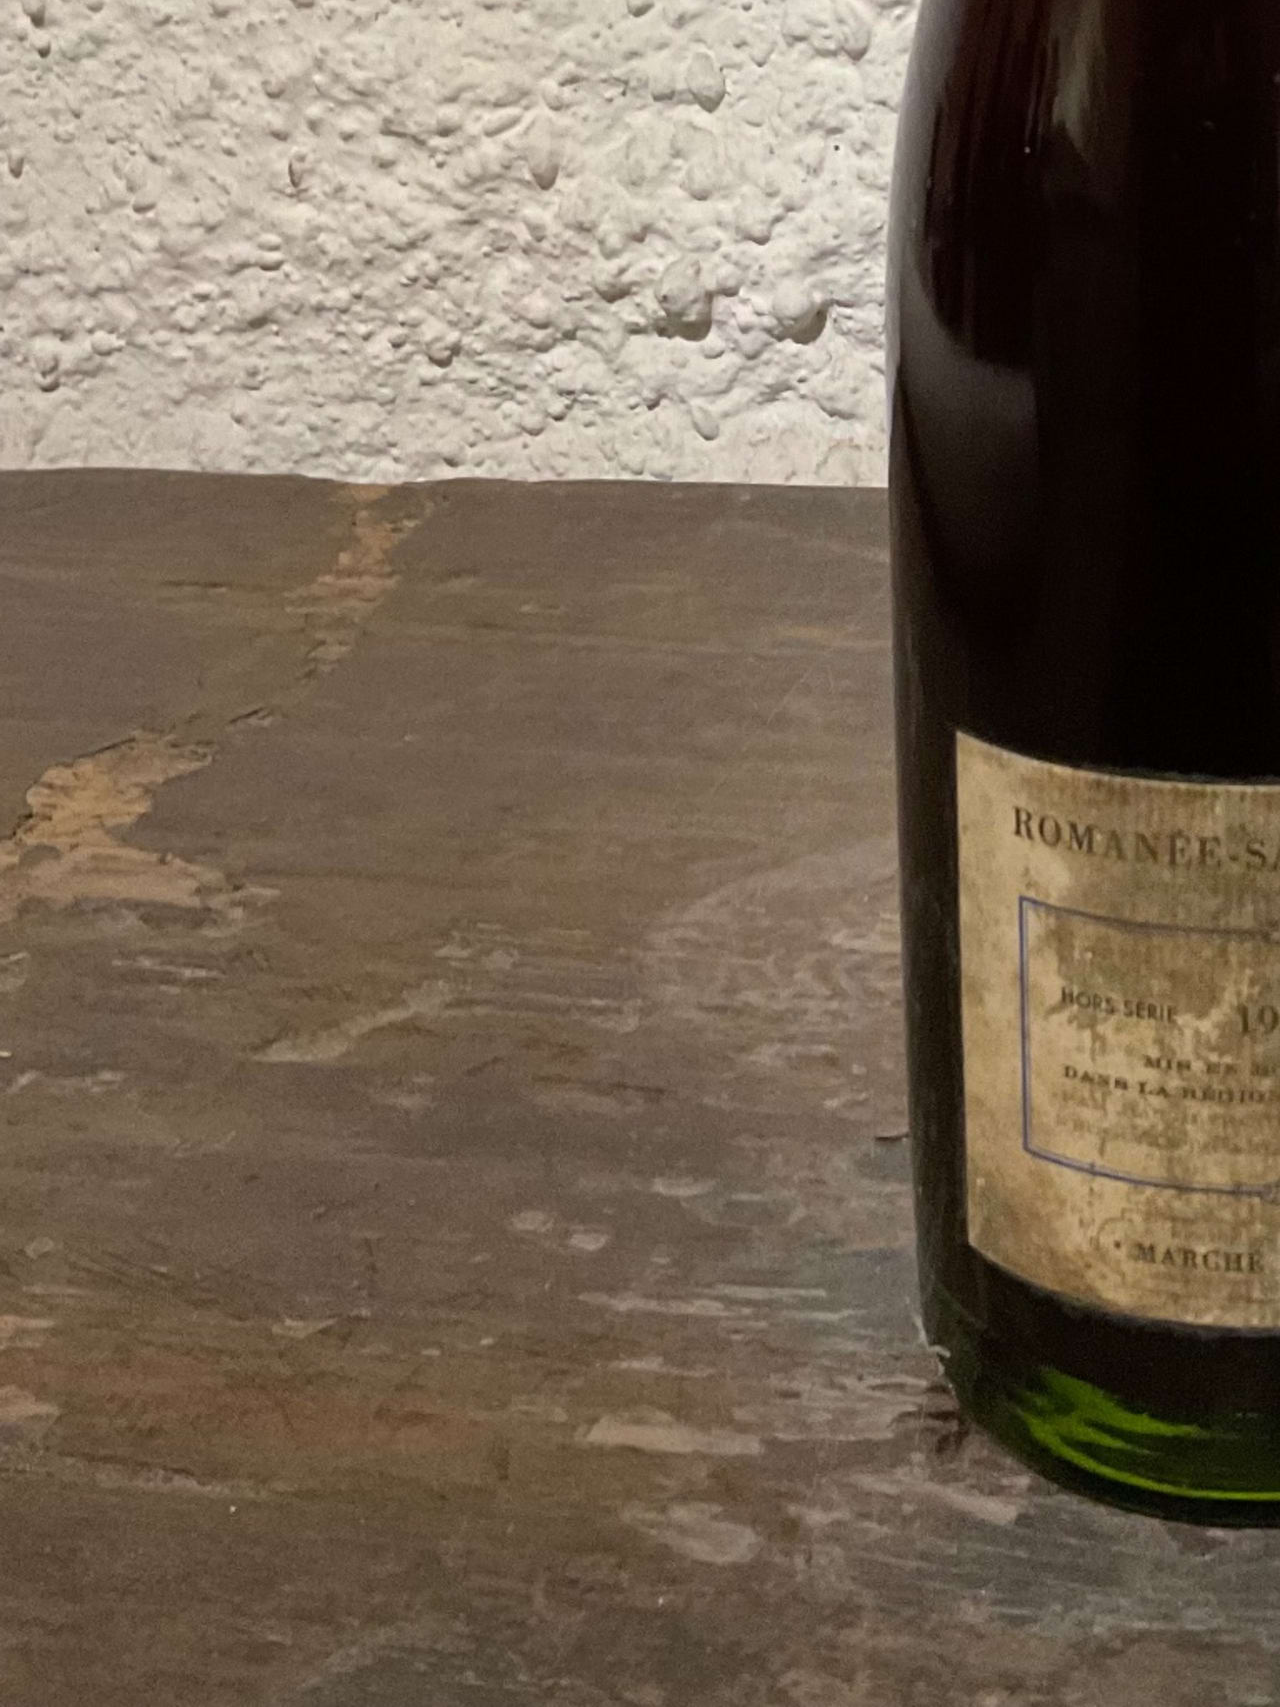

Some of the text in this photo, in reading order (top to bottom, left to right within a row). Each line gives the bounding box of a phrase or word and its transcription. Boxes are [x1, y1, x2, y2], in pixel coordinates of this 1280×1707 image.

[1060, 986, 1116, 1016] HORS
[1063, 1064, 1129, 1092] DANS
[1138, 1080, 1169, 1098] LA
